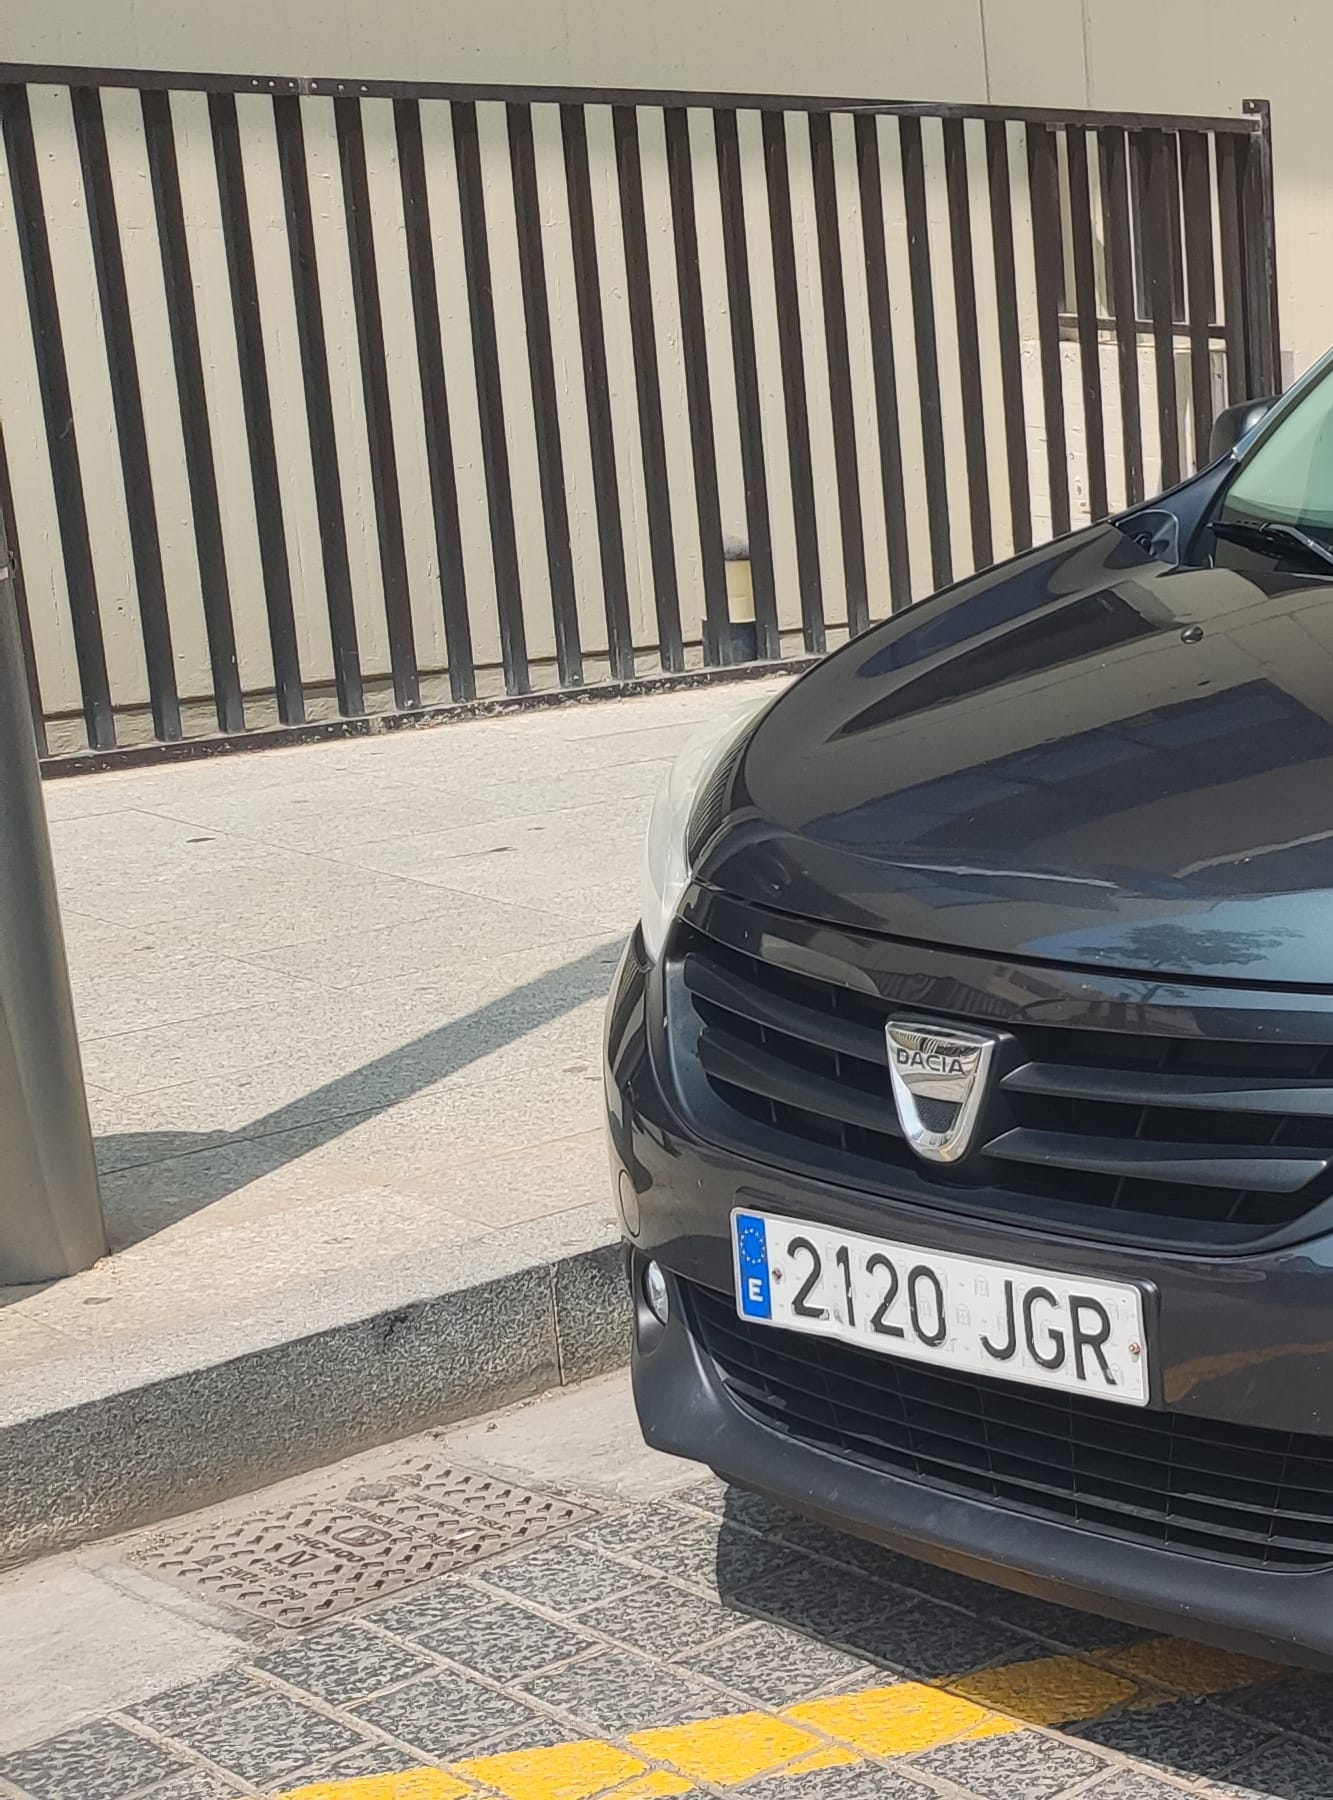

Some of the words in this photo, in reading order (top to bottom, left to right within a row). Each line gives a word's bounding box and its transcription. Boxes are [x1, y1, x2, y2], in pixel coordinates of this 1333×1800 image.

[896, 1047, 966, 1076] DACIA
[749, 1278, 763, 1302] E
[787, 1236, 946, 1348] 2120
[979, 1279, 1117, 1386] JGR
